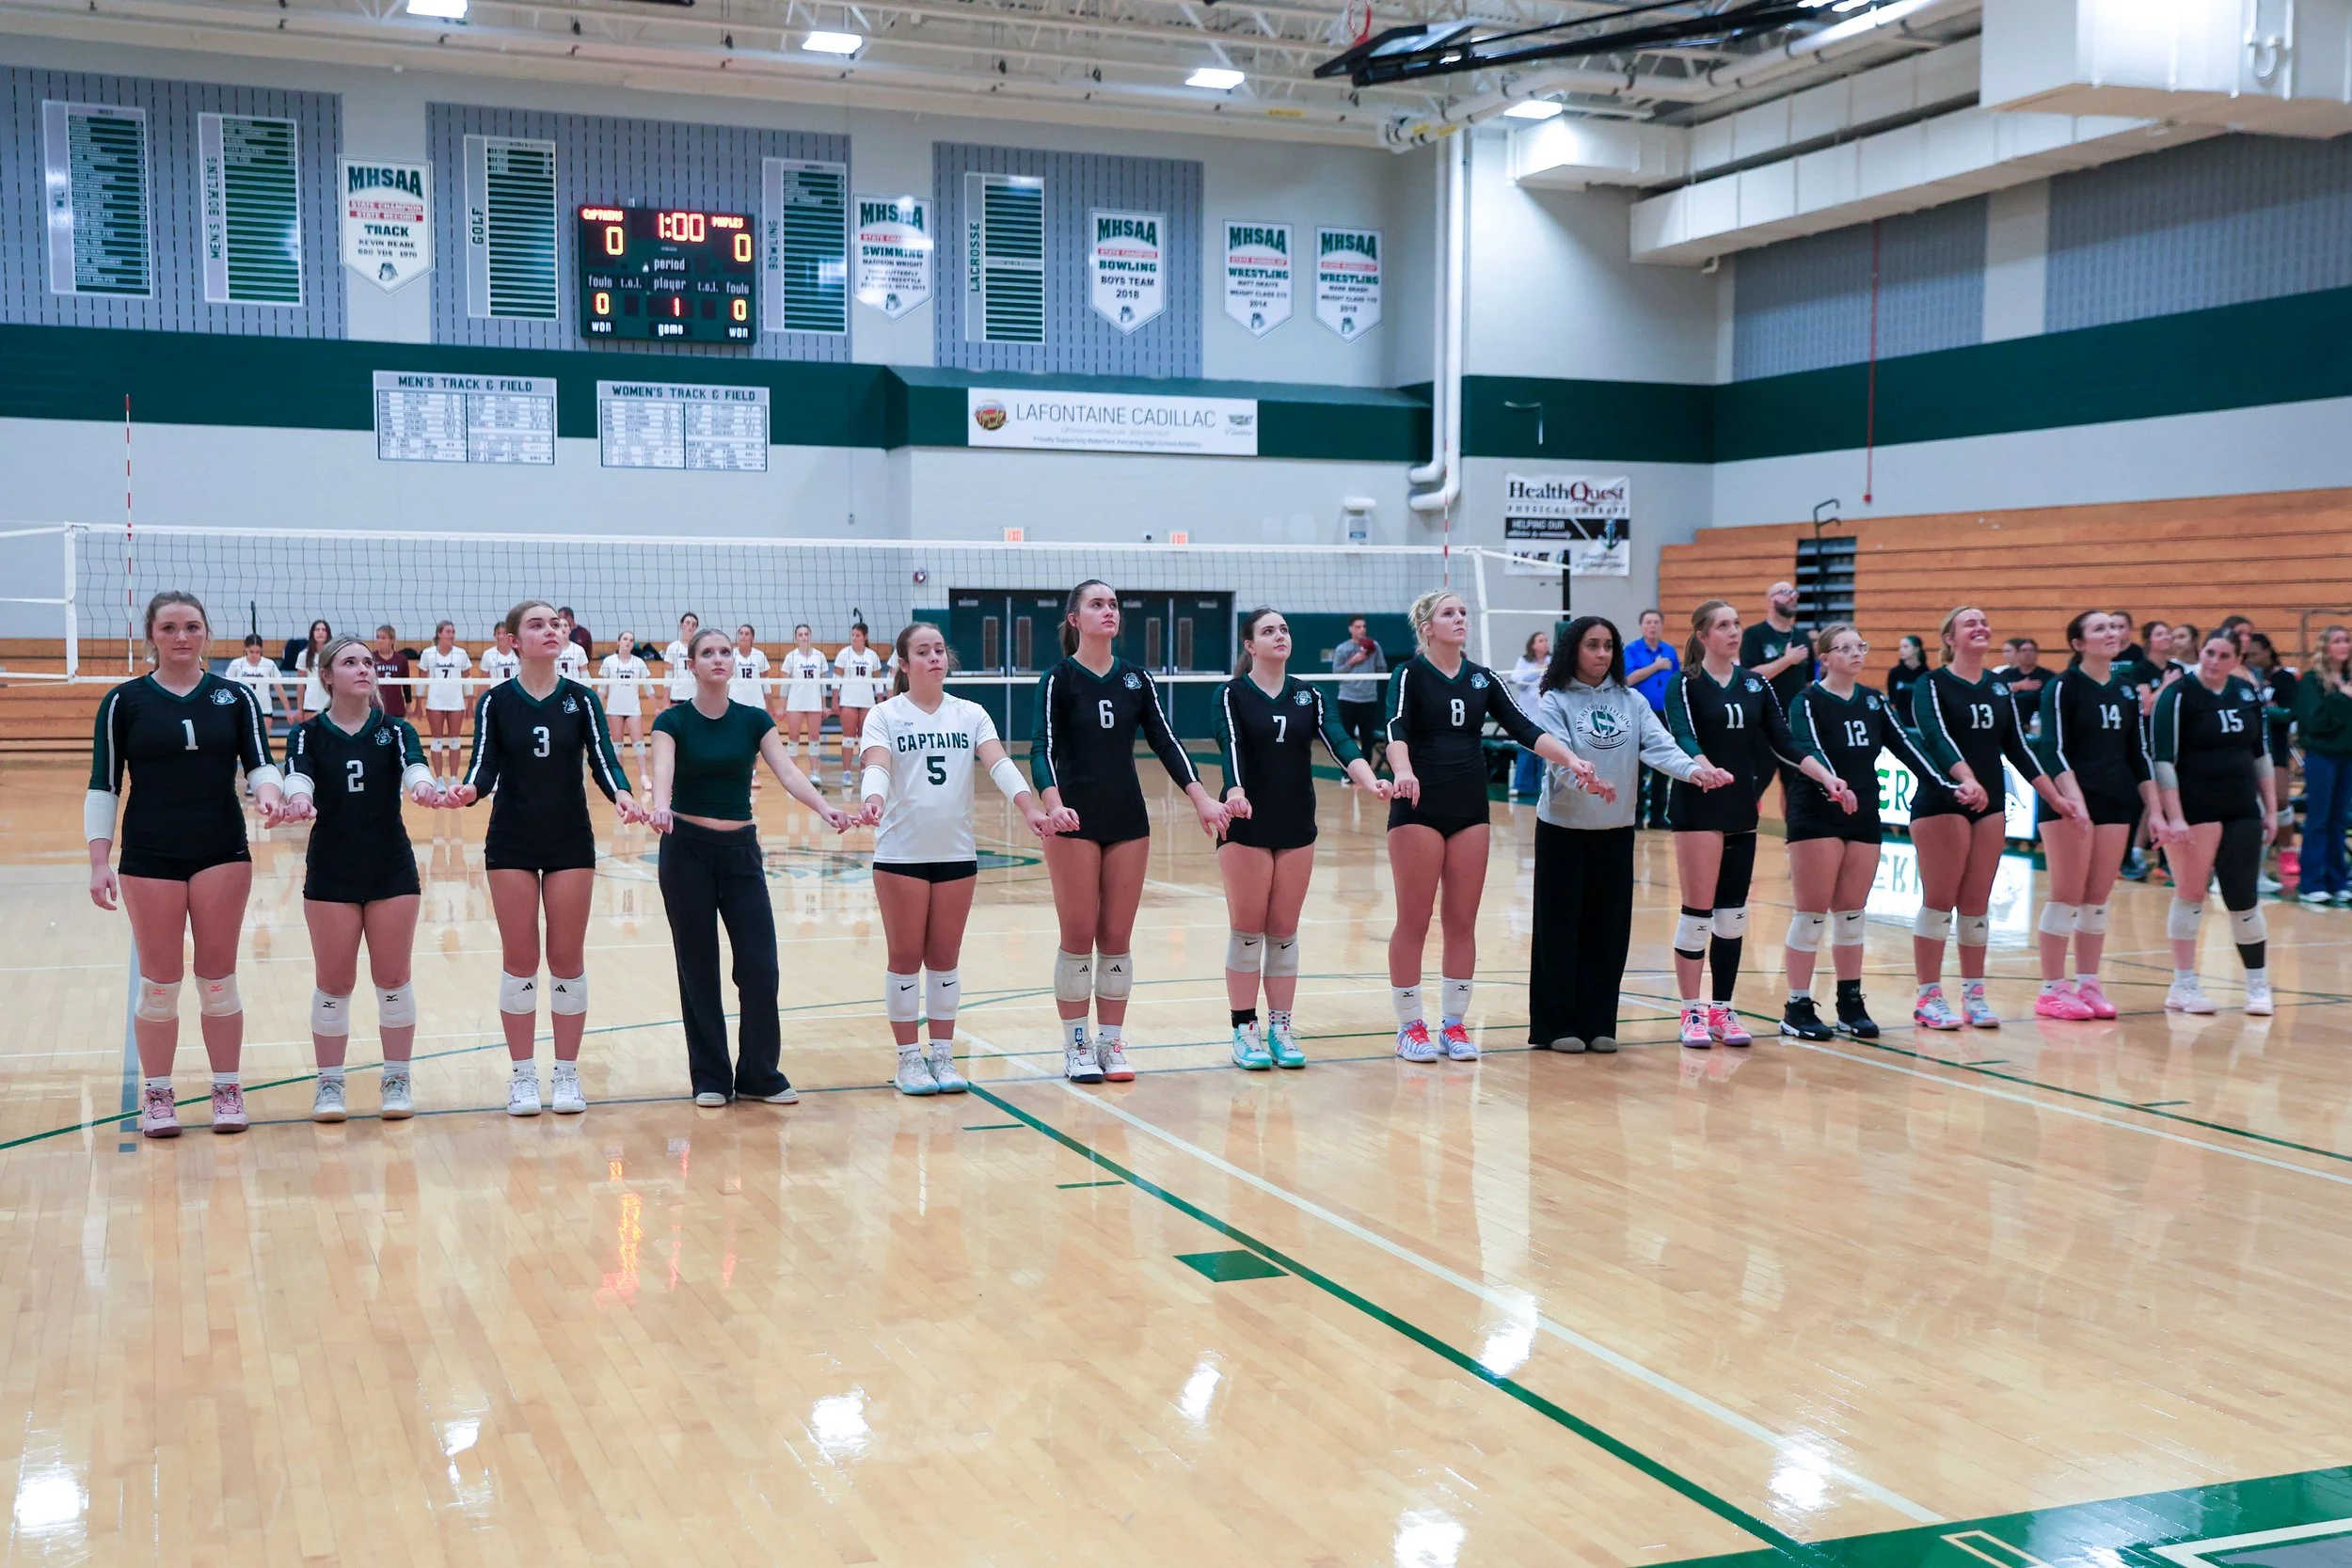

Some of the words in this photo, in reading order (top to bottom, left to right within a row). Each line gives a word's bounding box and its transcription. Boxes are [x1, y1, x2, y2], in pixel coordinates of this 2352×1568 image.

[207, 156, 219, 215] BOWLING
[348, 166, 422, 199] MHSAA
[364, 225, 409, 237] TRACK
[472, 208, 484, 245] GOLF
[658, 212, 706, 243] 1:00
[1098, 218, 1157, 246] MHSAA
[605, 226, 624, 256] 0
[734, 233, 752, 262] 0
[768, 219, 779, 270] BOWLING
[1230, 226, 1286, 255] MHSAA
[1321, 232, 1377, 261] MHSAA
[863, 246, 924, 259] SWIMMING
[970, 222, 980, 292] LACROSSE
[654, 258, 686, 271] period
[1099, 260, 1156, 273] BOWLING
[1229, 267, 1289, 280] WRESTLING
[588, 275, 612, 288] fouls
[654, 277, 687, 292] player
[726, 282, 750, 294] fouls
[1101, 276, 1125, 285] BOYS
[1129, 277, 1154, 286] TEAM
[1320, 273, 1379, 285] WRESTLING
[595, 292, 611, 315] 0
[1116, 290, 1139, 299] 2018
[673, 297, 680, 317] 1
[733, 298, 747, 322] 0
[592, 322, 612, 332] won
[659, 324, 684, 337] game
[729, 327, 748, 339] won
[399, 376, 434, 388] MEN'S
[441, 377, 480, 389] TRACK
[501, 380, 532, 391] FIELD
[612, 386, 663, 398] WOMEN'S
[670, 388, 706, 399] TRACK
[725, 390, 755, 401] FIELD
[1016, 404, 1126, 424] LAFONTAINE
[1132, 408, 1216, 428] CADILLAC
[1509, 481, 1624, 506] HealthQuest
[1508, 505, 1565, 514] PHYSICAL
[1512, 519, 1547, 530] HELPING
[1548, 520, 1565, 530] OUR
[442, 670, 448, 678] 7
[562, 662, 568, 673] 9
[741, 669, 753, 678] 12
[803, 670, 815, 678] 15
[855, 666, 866, 676] 16
[1098, 699, 1115, 729] 6
[1451, 698, 1466, 727] 8
[1724, 704, 1744, 729] 11
[1970, 704, 1994, 729] 13
[2099, 705, 2122, 729] 14
[2217, 708, 2245, 733] 15
[182, 719, 199, 751] 1
[1272, 715, 1287, 743] 7
[1843, 720, 1869, 747] 12
[532, 726, 550, 757] 3
[898, 733, 969, 752] CAPTAINS
[346, 760, 364, 793] 2
[927, 756, 946, 785] 5
